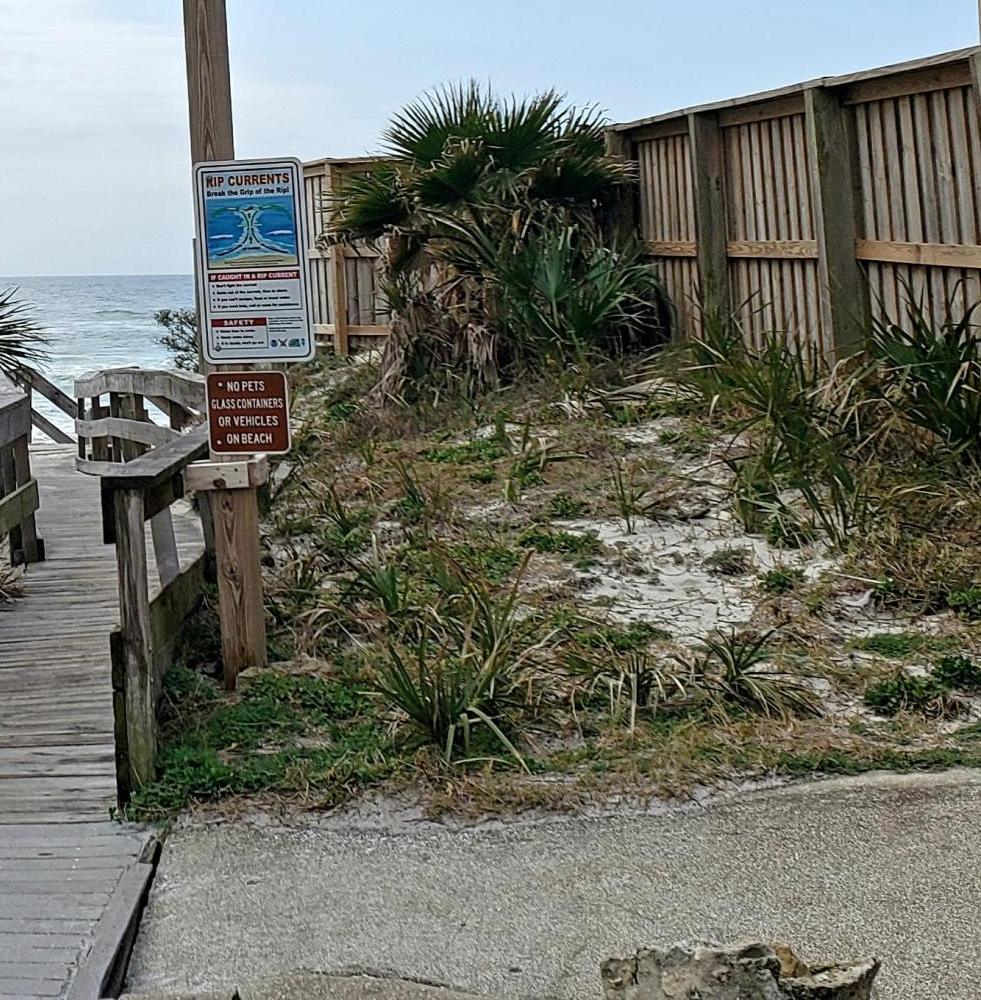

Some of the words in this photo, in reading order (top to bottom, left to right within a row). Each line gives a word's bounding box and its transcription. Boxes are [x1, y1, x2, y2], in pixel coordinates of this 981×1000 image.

[206, 175, 224, 188] RIP
[228, 173, 290, 186] CURRENTS
[226, 381, 240, 392] NO
[241, 380, 265, 391] PETS
[211, 399, 235, 409] GLASS
[236, 397, 284, 409] CONTAINERS
[218, 416, 231, 427] OR
[233, 415, 279, 426] VEHICLES
[226, 433, 240, 444] ON
[241, 433, 273, 444] BEACH
